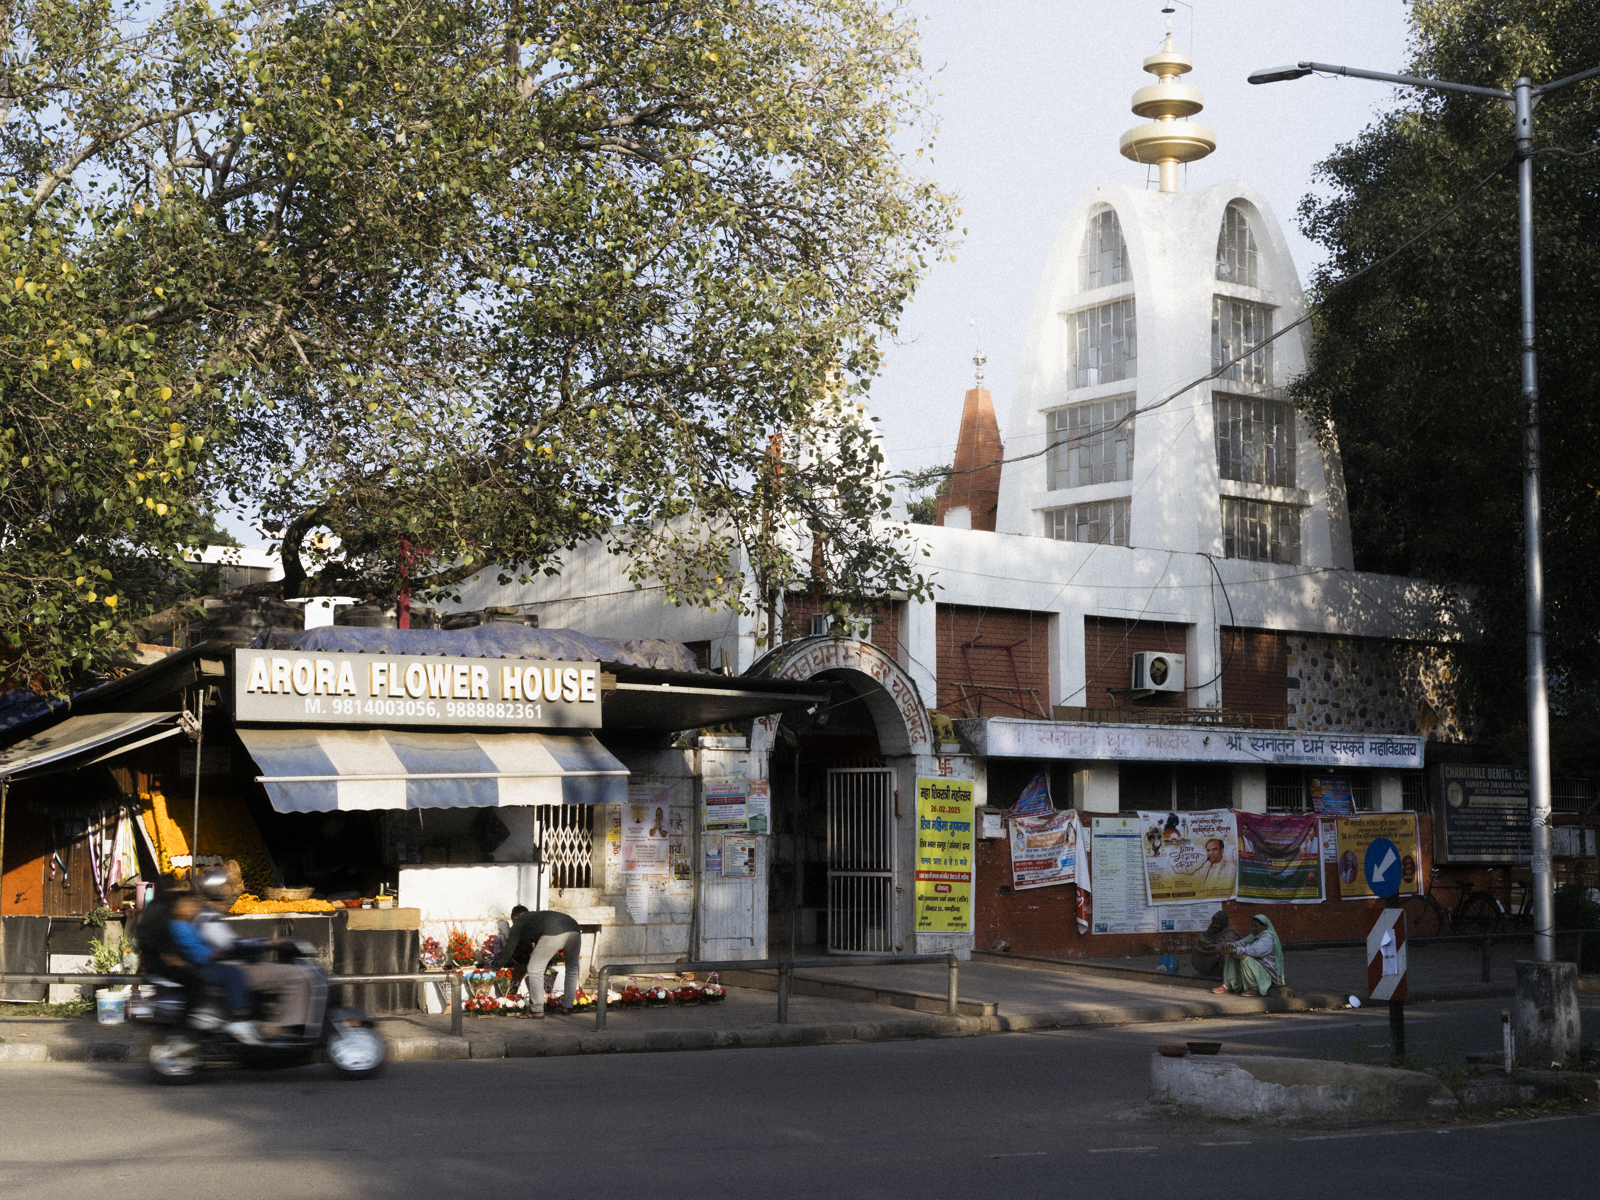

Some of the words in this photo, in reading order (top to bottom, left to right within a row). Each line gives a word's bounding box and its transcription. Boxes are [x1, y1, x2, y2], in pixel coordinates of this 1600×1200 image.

[246, 657, 357, 696] ARORA
[369, 661, 490, 699] FLOWER
[500, 665, 597, 703] HOUSE
[304, 698, 327, 715] M.
[332, 699, 441, 719] 9814003056,
[446, 703, 542, 720] 9888882361
[1226, 733, 1242, 752] श्री
[1248, 736, 1295, 754] सनातन
[1302, 735, 1324, 754] धर्म
[1330, 738, 1364, 758] संस्कृत
[1369, 738, 1416, 756] महाविद्यालय
[1445, 766, 1486, 779] CHARITABLE
[1488, 768, 1512, 779] DENTAL
[920, 788, 930, 800] महा
[951, 786, 971, 802] महोत्सव
[930, 804, 960, 814] 26.02.2025
[920, 816, 931, 830] शिव
[932, 816, 948, 832] महिमा
[949, 821, 970, 837] गुणगान
